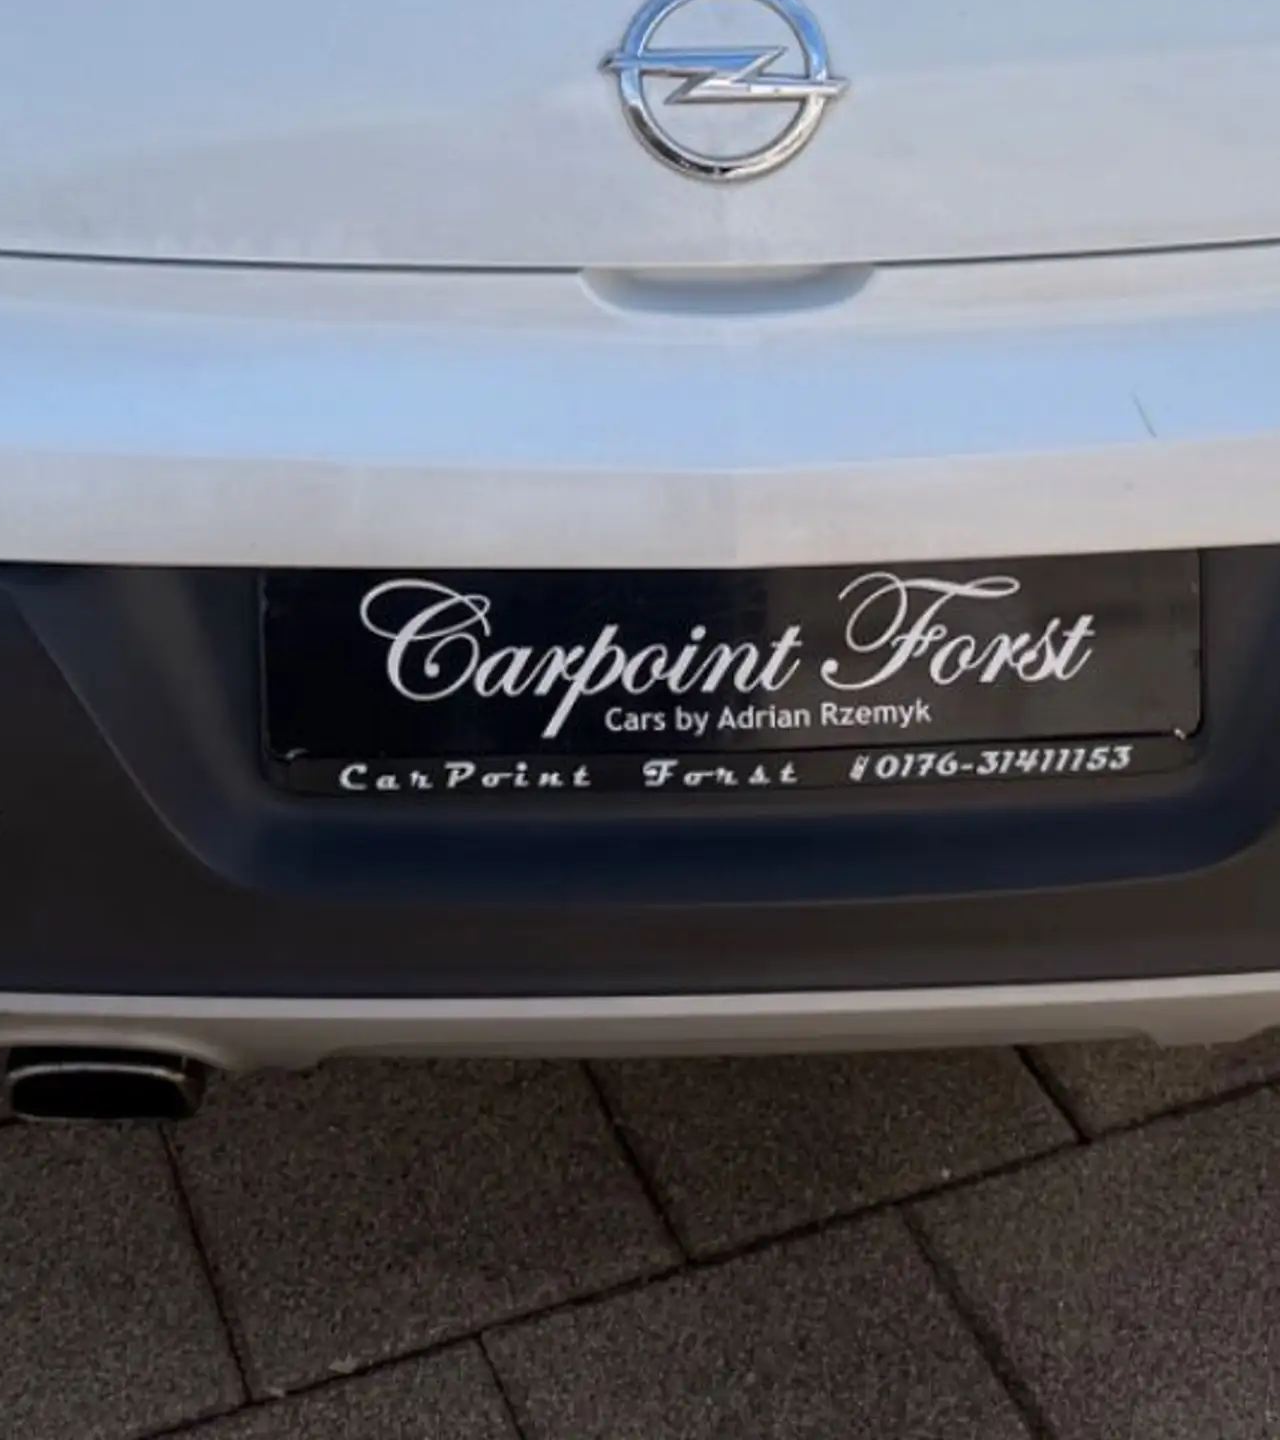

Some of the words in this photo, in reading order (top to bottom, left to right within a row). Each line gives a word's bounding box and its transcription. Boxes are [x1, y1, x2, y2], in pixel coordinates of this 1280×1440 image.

[360, 578, 802, 739] Carpoint
[821, 571, 1095, 691] Forst
[605, 707, 666, 731] Cars
[674, 705, 709, 736] by
[717, 704, 811, 729] Adrian
[821, 698, 933, 728] Rzemyk
[642, 758, 801, 788] Forst
